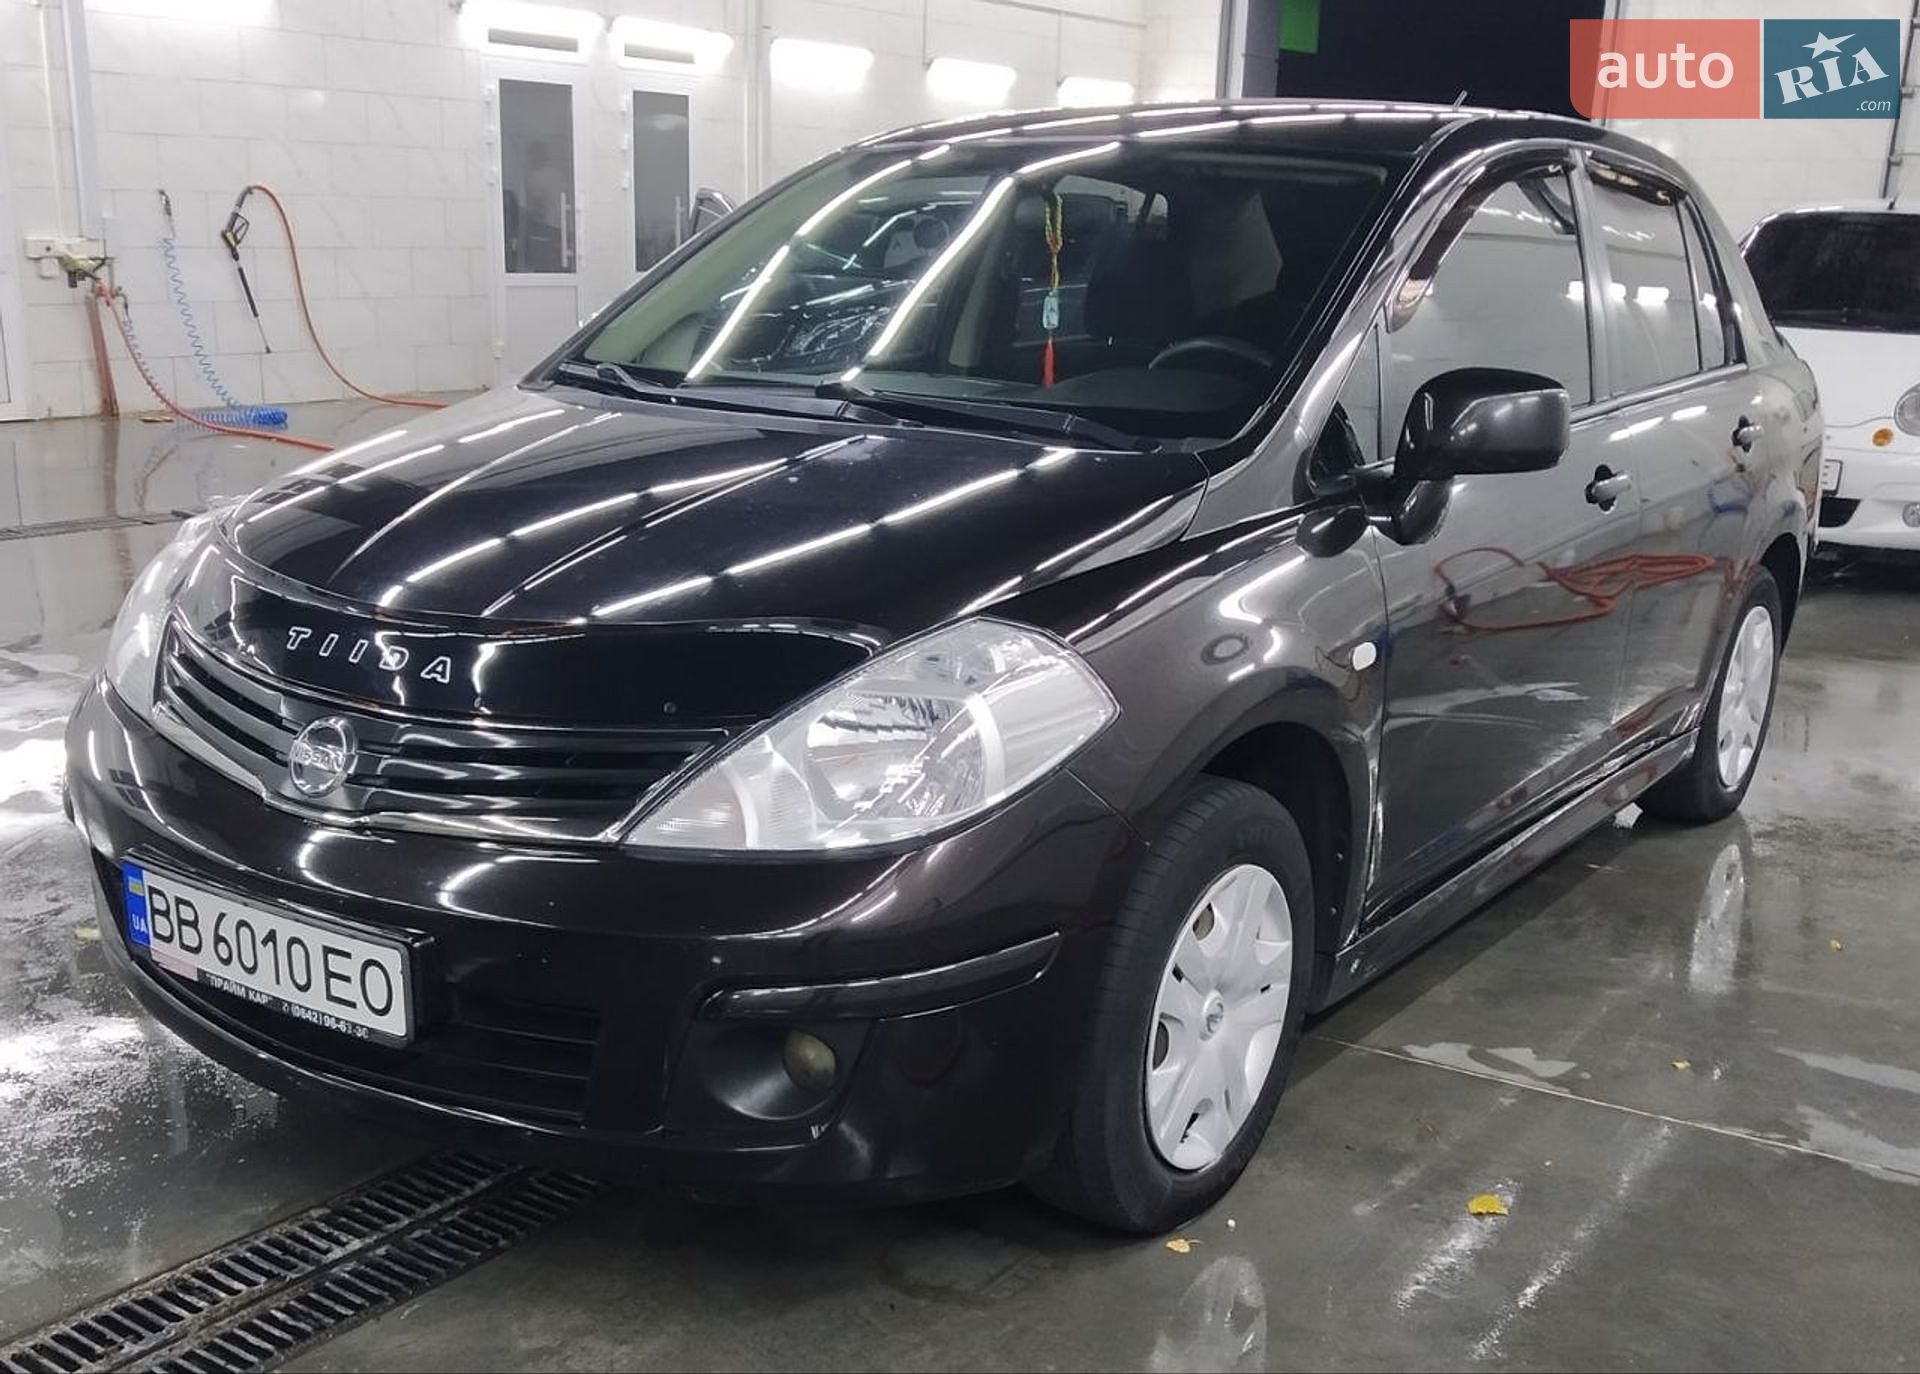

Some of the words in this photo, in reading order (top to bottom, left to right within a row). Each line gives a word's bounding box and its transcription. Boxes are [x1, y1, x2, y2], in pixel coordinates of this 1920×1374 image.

[286, 626, 451, 684] TIIDA
[132, 913, 148, 935] UA
[147, 885, 202, 955] BB
[213, 912, 312, 993] 6010
[322, 945, 393, 1017] EO
